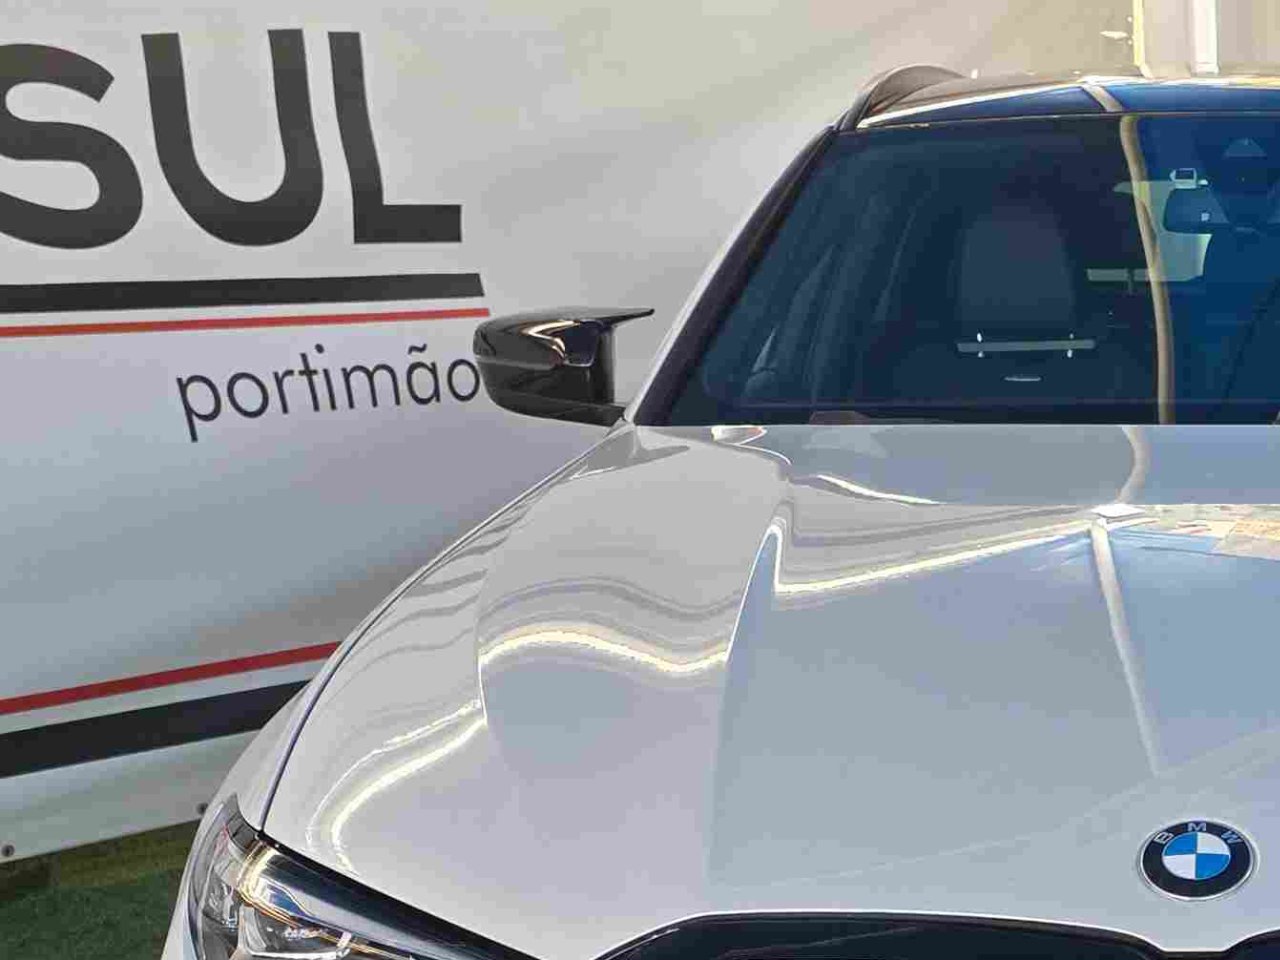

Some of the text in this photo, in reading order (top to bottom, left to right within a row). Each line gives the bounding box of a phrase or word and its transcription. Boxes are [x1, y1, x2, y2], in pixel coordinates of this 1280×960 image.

[0, 28, 461, 249] SUL
[176, 342, 480, 443] portimão
[1153, 822, 1243, 844] BMW
